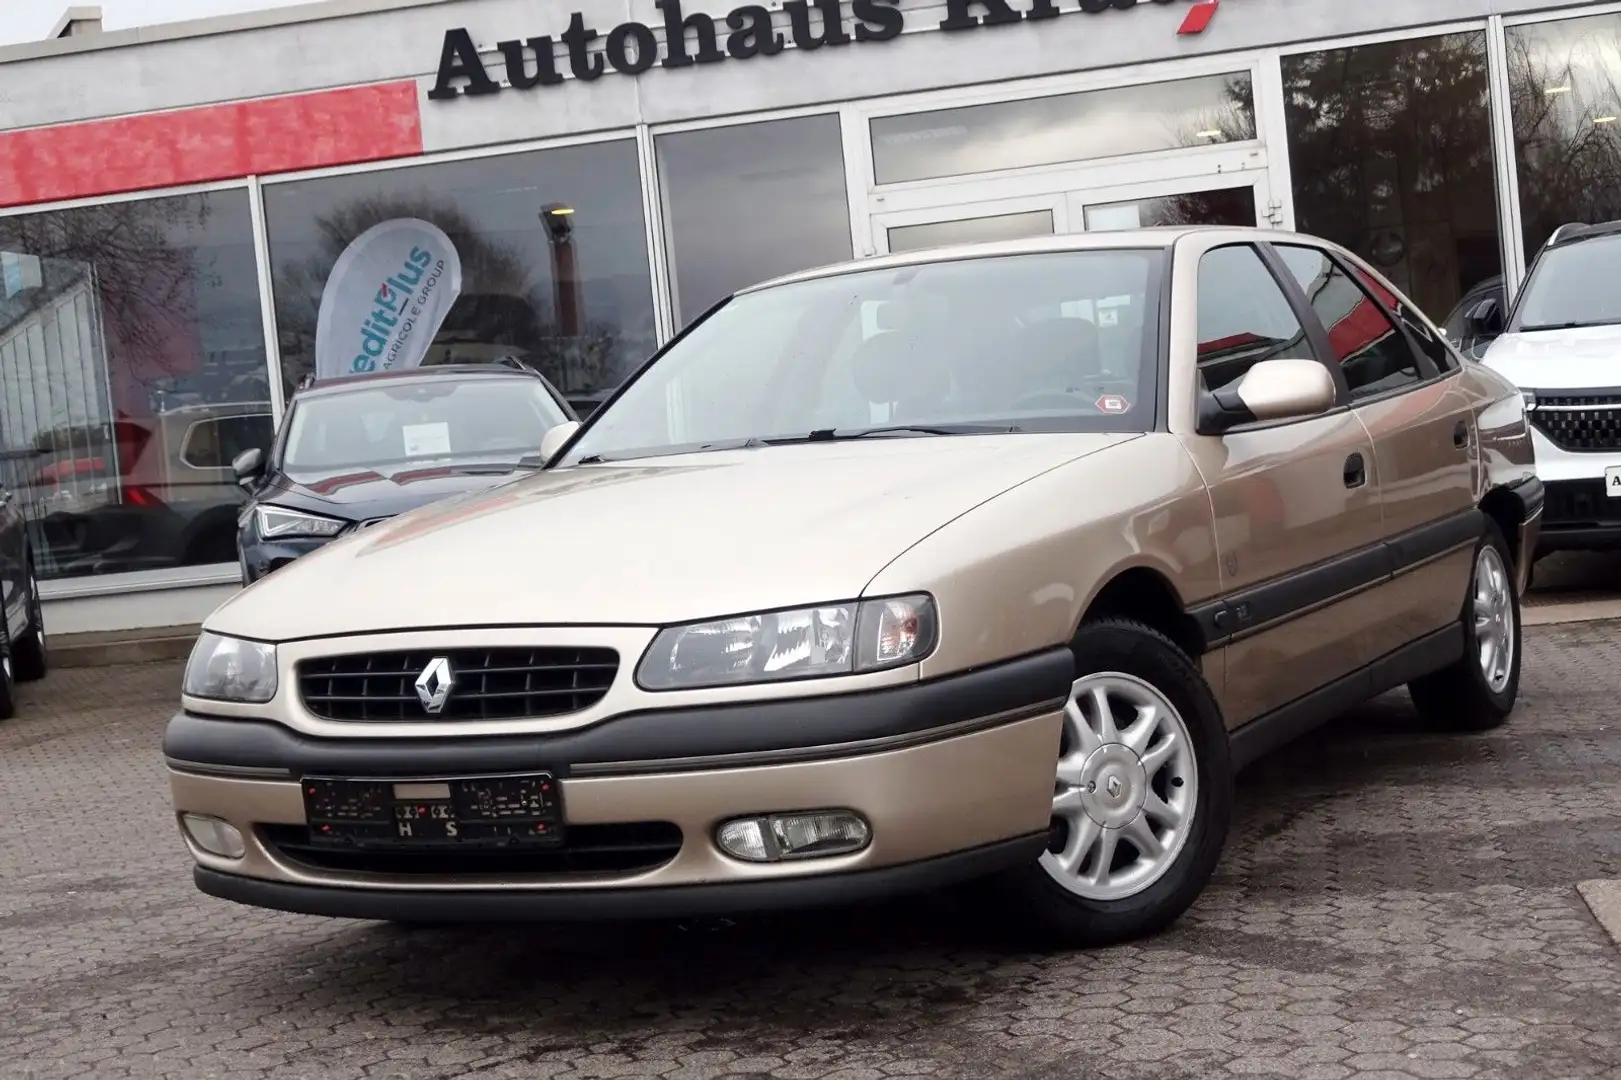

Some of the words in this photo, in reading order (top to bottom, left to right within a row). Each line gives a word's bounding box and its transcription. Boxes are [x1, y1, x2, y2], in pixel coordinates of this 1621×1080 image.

[428, 0, 904, 99] Autohaus
[349, 246, 432, 374] editPlus
[383, 307, 421, 370] AGRICOLE
[418, 259, 445, 306] GROUP
